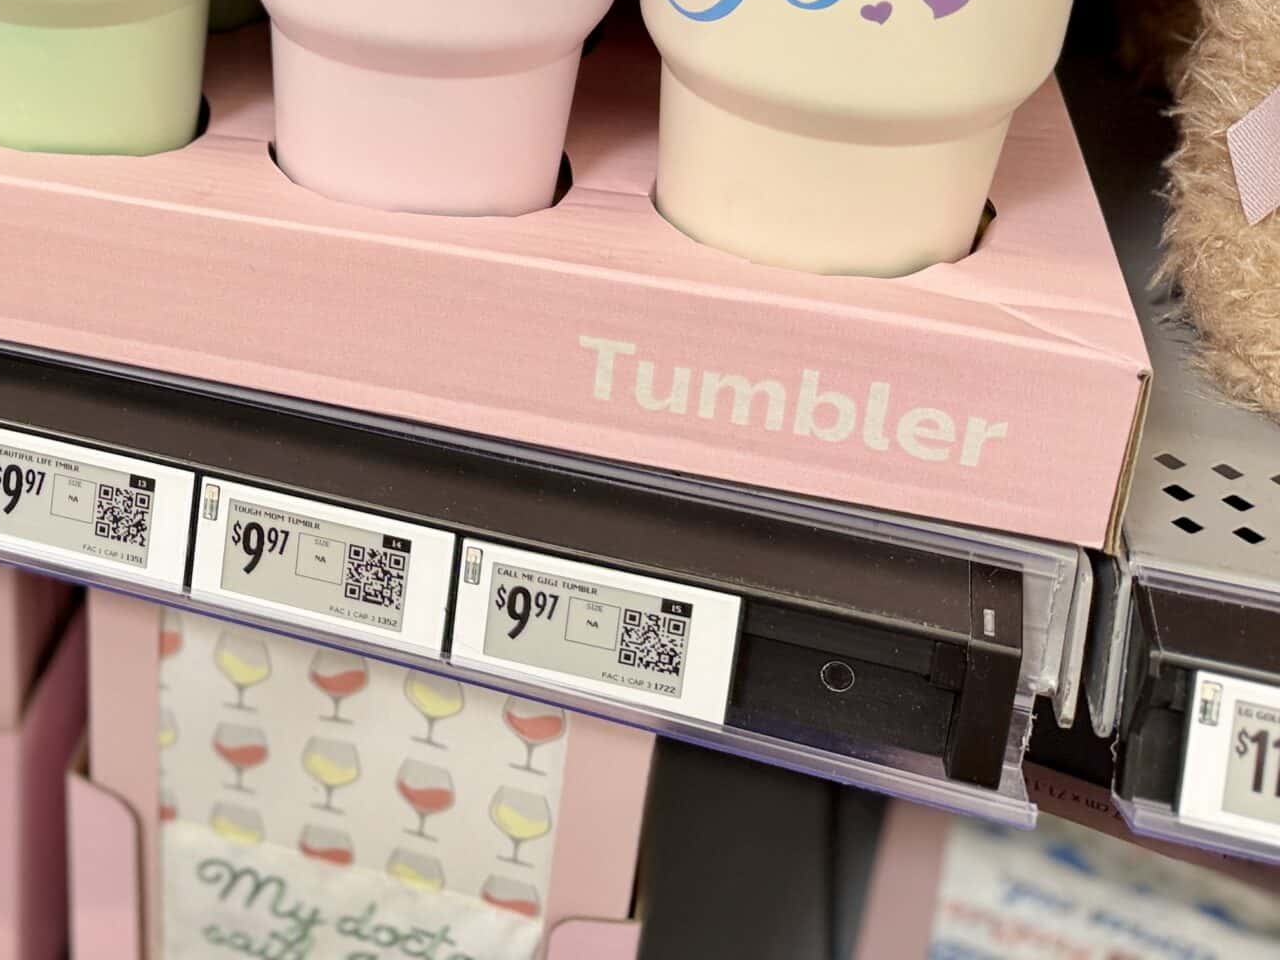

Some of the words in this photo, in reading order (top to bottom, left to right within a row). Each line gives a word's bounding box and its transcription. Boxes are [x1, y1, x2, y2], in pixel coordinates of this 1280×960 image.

[579, 335, 1009, 467] Tumbler
[233, 503, 262, 516] TOUGH
[264, 510, 284, 521] MOM
[497, 567, 518, 578] CALL
[521, 572, 534, 582] ME
[537, 576, 558, 587] GIGI
[561, 581, 597, 595] TUMBLR
